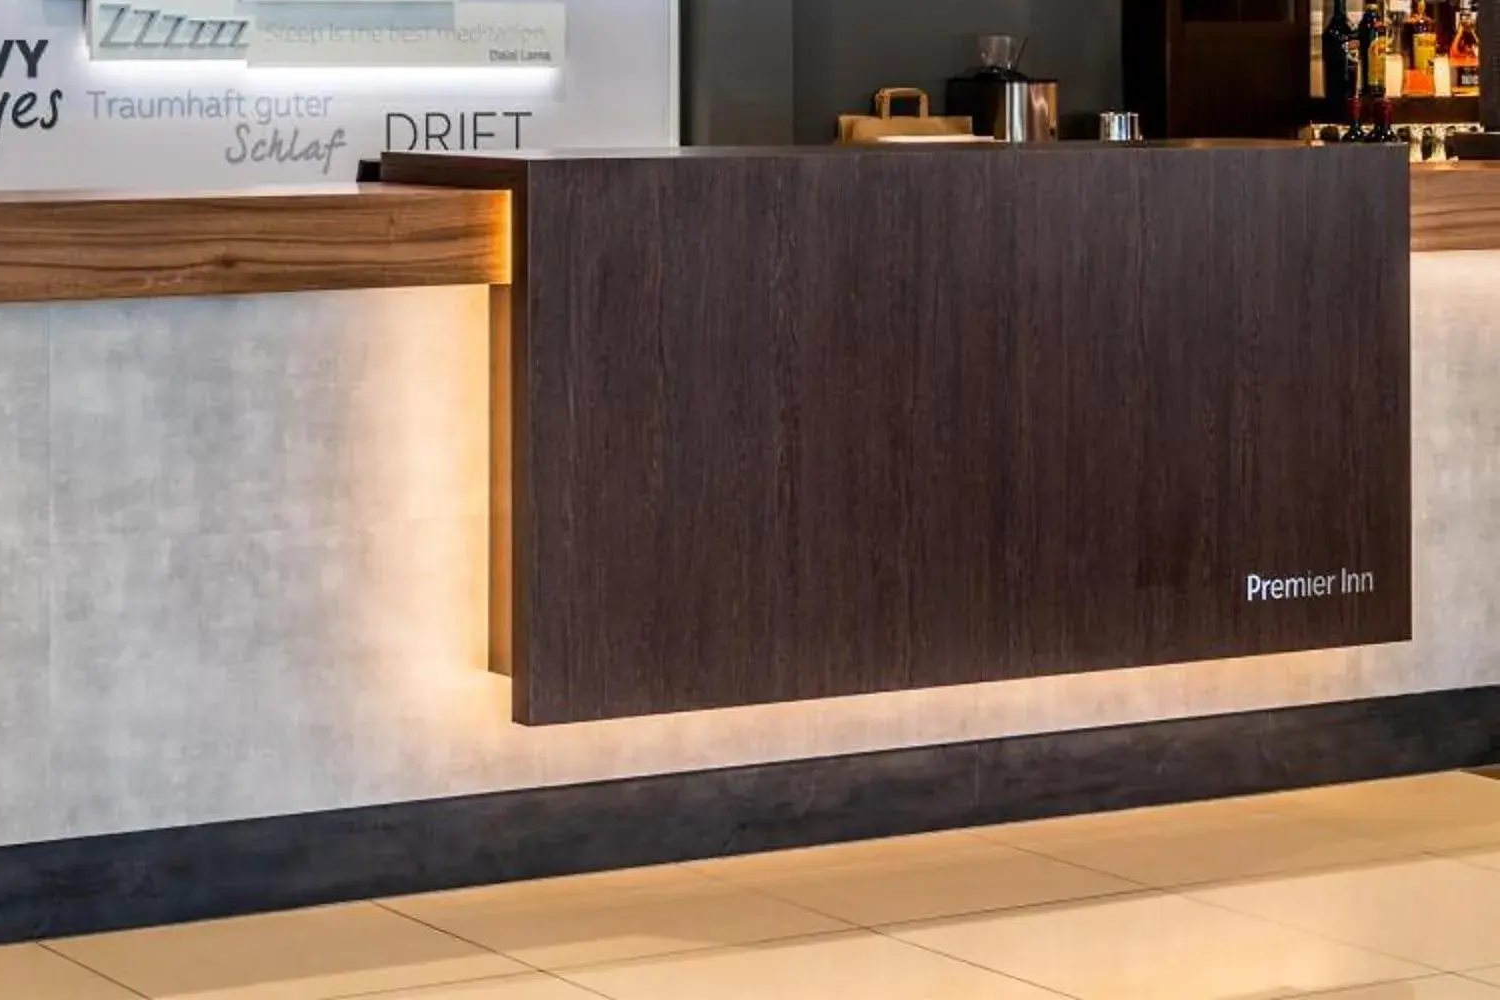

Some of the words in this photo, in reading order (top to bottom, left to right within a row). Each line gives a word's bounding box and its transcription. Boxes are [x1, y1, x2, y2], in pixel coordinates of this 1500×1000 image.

[86, 89, 246, 119] Traumhaft
[255, 95, 332, 124] guter
[226, 121, 347, 173] Schlaf
[386, 112, 532, 151] DRIFT
[1247, 570, 1335, 601] Premier
[1341, 567, 1373, 594] Inn
